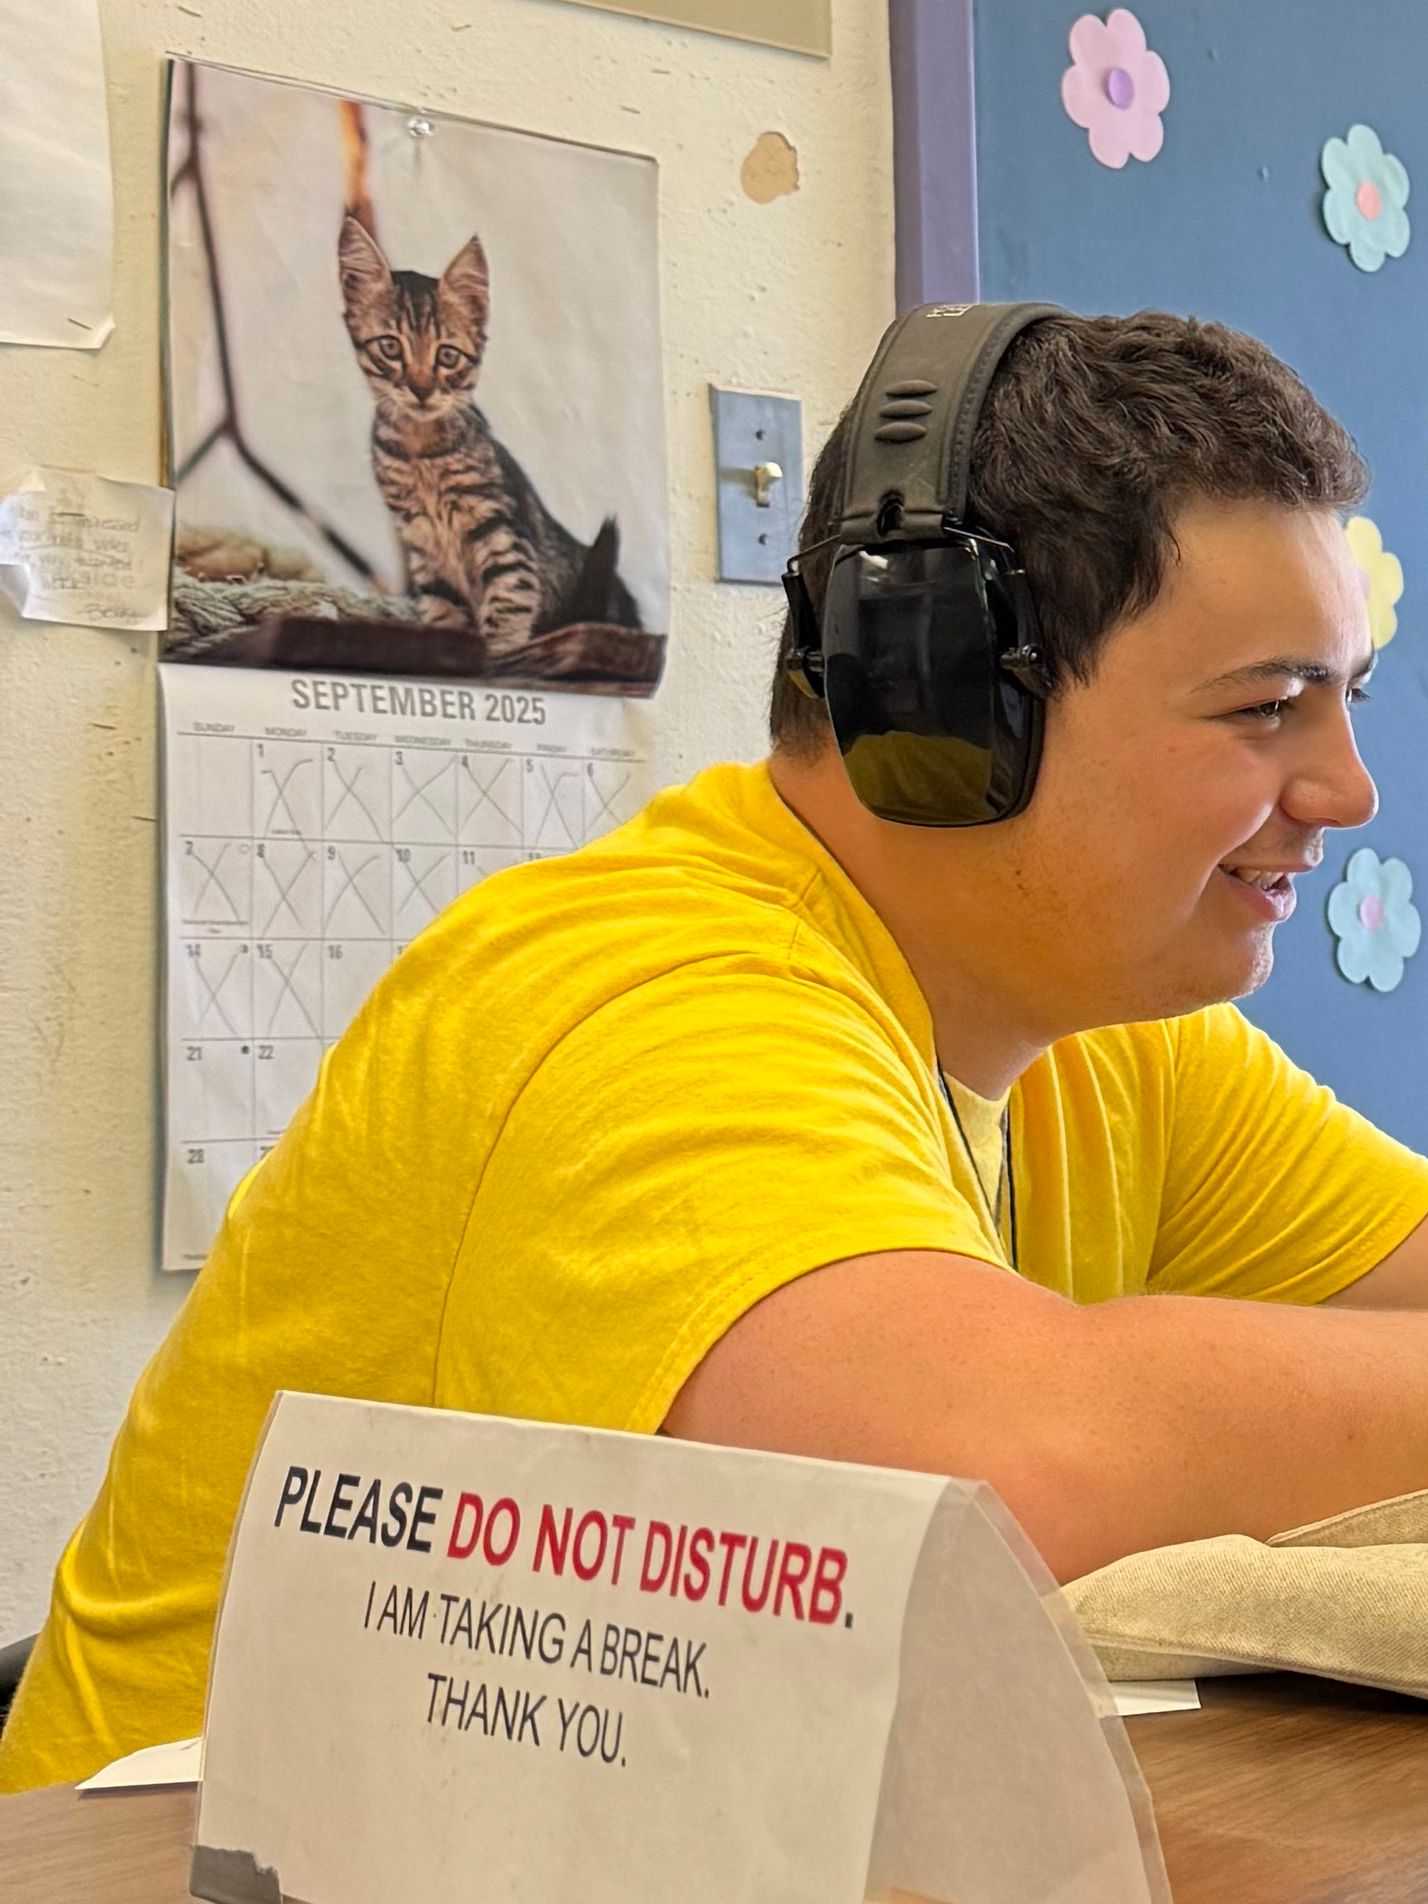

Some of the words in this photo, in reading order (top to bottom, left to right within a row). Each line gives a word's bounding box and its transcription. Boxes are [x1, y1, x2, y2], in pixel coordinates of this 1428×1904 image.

[290, 679, 476, 721] SEPTEMBER
[485, 693, 547, 725] 2025
[257, 743, 264, 757] 1
[327, 747, 336, 762] 2
[394, 751, 404, 765] 3
[526, 759, 534, 773] 5
[587, 762, 595, 777] 6
[327, 846, 336, 860] 9
[395, 848, 411, 863] 10
[462, 851, 476, 865] 11
[257, 944, 273, 959] 15
[328, 945, 344, 959] 16
[186, 1047, 202, 1061] 21
[258, 1045, 274, 1060] 22
[187, 1149, 205, 1164] 28
[274, 1465, 444, 1554] PLEASE
[447, 1491, 521, 1567] DO
[532, 1504, 636, 1586] NOT
[639, 1520, 854, 1629] DISTURB.
[363, 1580, 377, 1629] I
[376, 1583, 430, 1640] AM
[440, 1592, 567, 1665] TAKING
[570, 1618, 593, 1673] A
[599, 1622, 710, 1699] BREAK.
[427, 1672, 548, 1748] THANK
[557, 1697, 627, 1768] YOU.
